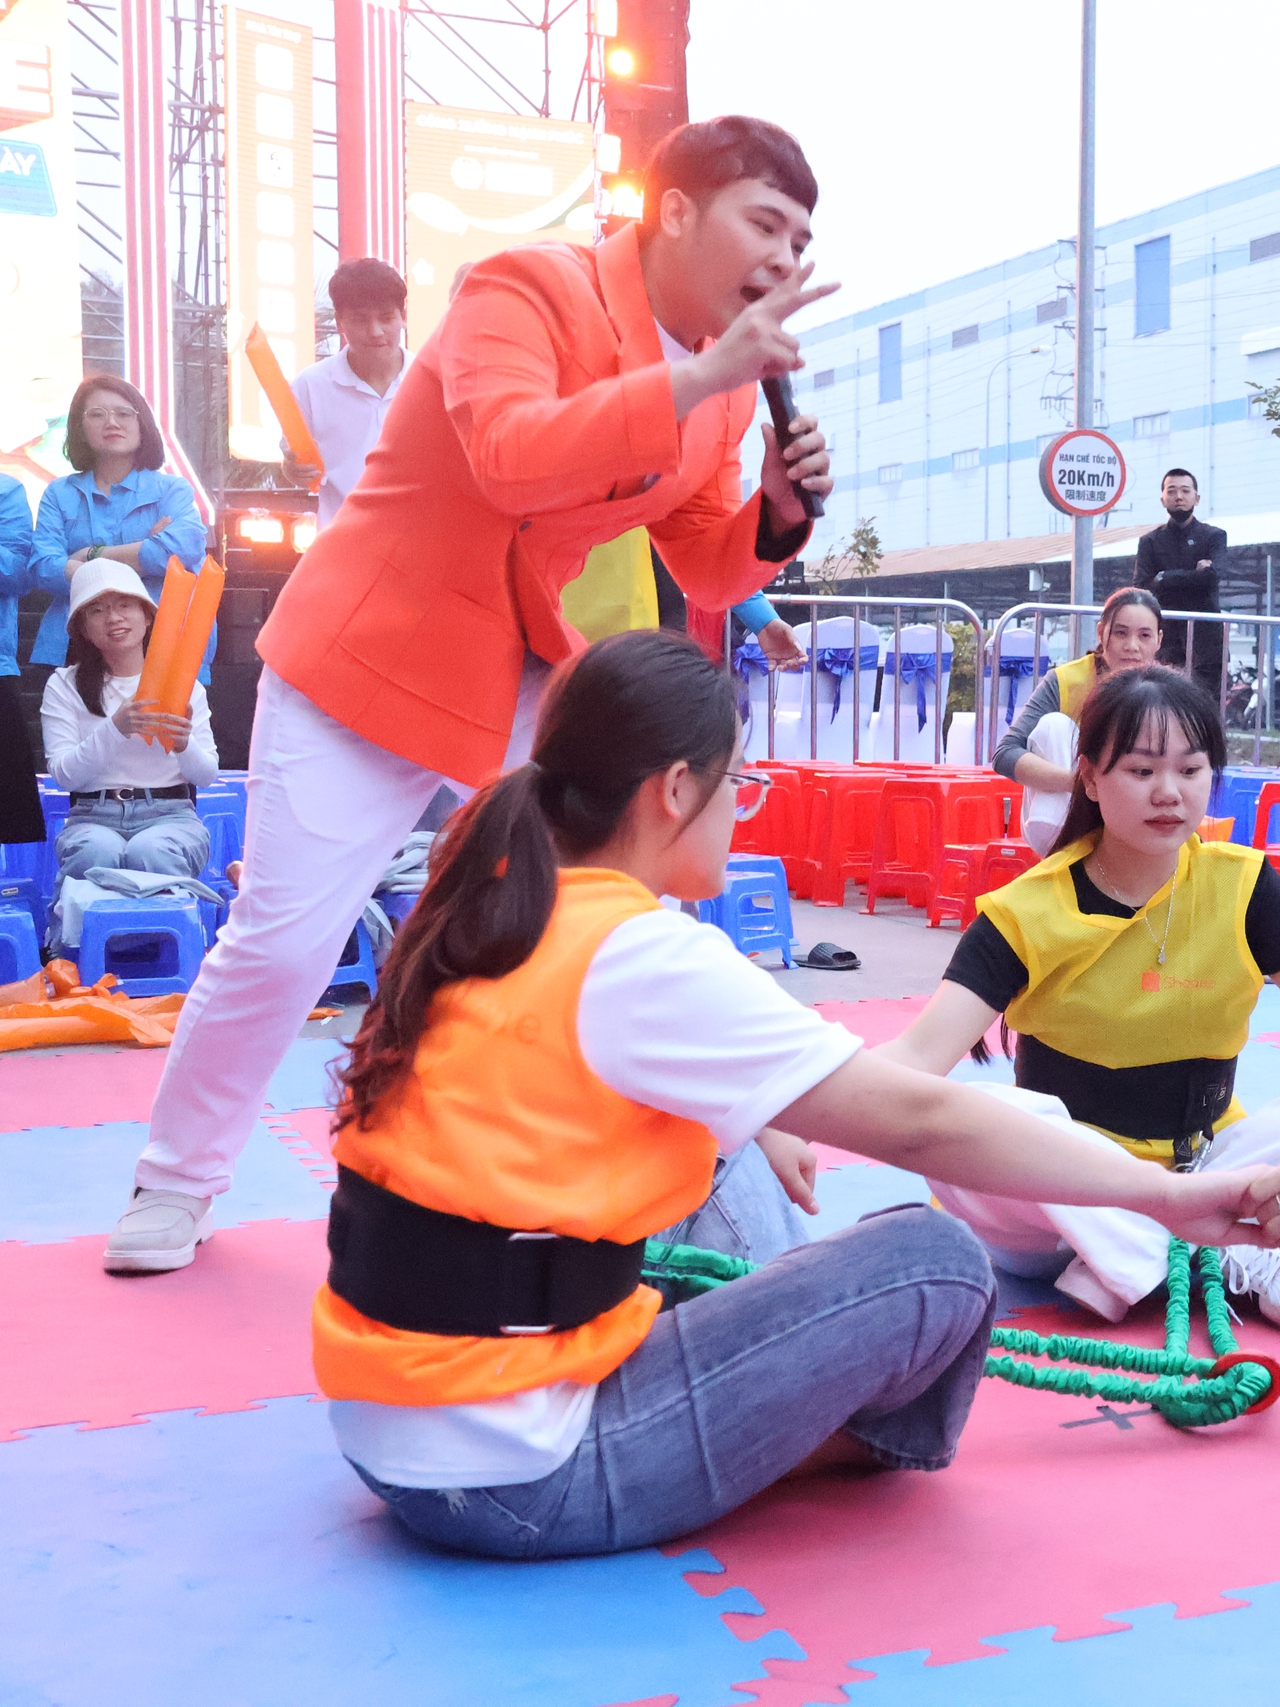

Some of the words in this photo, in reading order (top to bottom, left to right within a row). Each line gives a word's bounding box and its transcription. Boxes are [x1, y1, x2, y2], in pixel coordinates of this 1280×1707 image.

[1059, 453, 1074, 464] HẠN
[1076, 453, 1090, 463] CHẾ
[1092, 453, 1105, 464] TỐC
[1107, 454, 1117, 467] ĐỘ
[1058, 469, 1115, 488] 20Km/h
[1065, 489, 1107, 502] 限制速度
